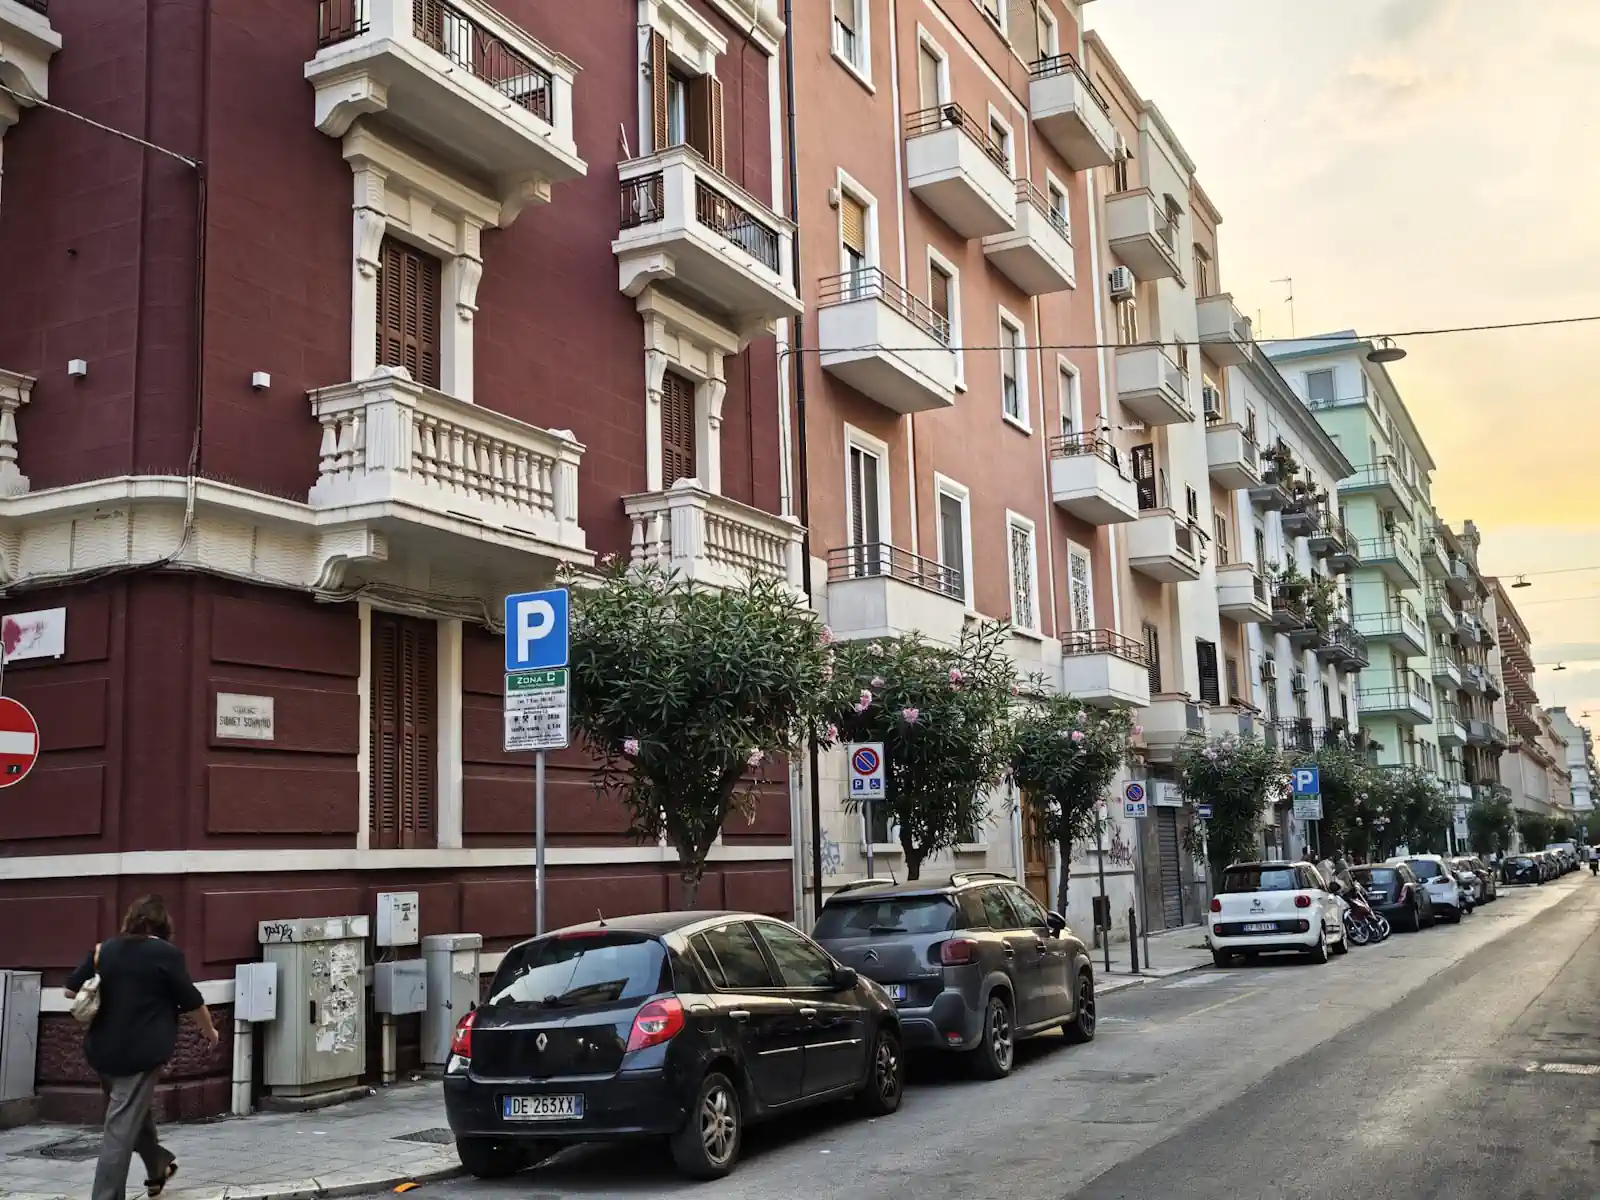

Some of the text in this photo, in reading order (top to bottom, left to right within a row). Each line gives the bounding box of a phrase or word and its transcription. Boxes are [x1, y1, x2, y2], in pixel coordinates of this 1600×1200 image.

[517, 600, 555, 663] P
[517, 676, 542, 685] ZONA
[547, 672, 556, 682] C
[854, 780, 862, 789] P
[1297, 770, 1313, 791] P
[513, 1098, 529, 1114] DE
[533, 1097, 574, 1114] 263XX
